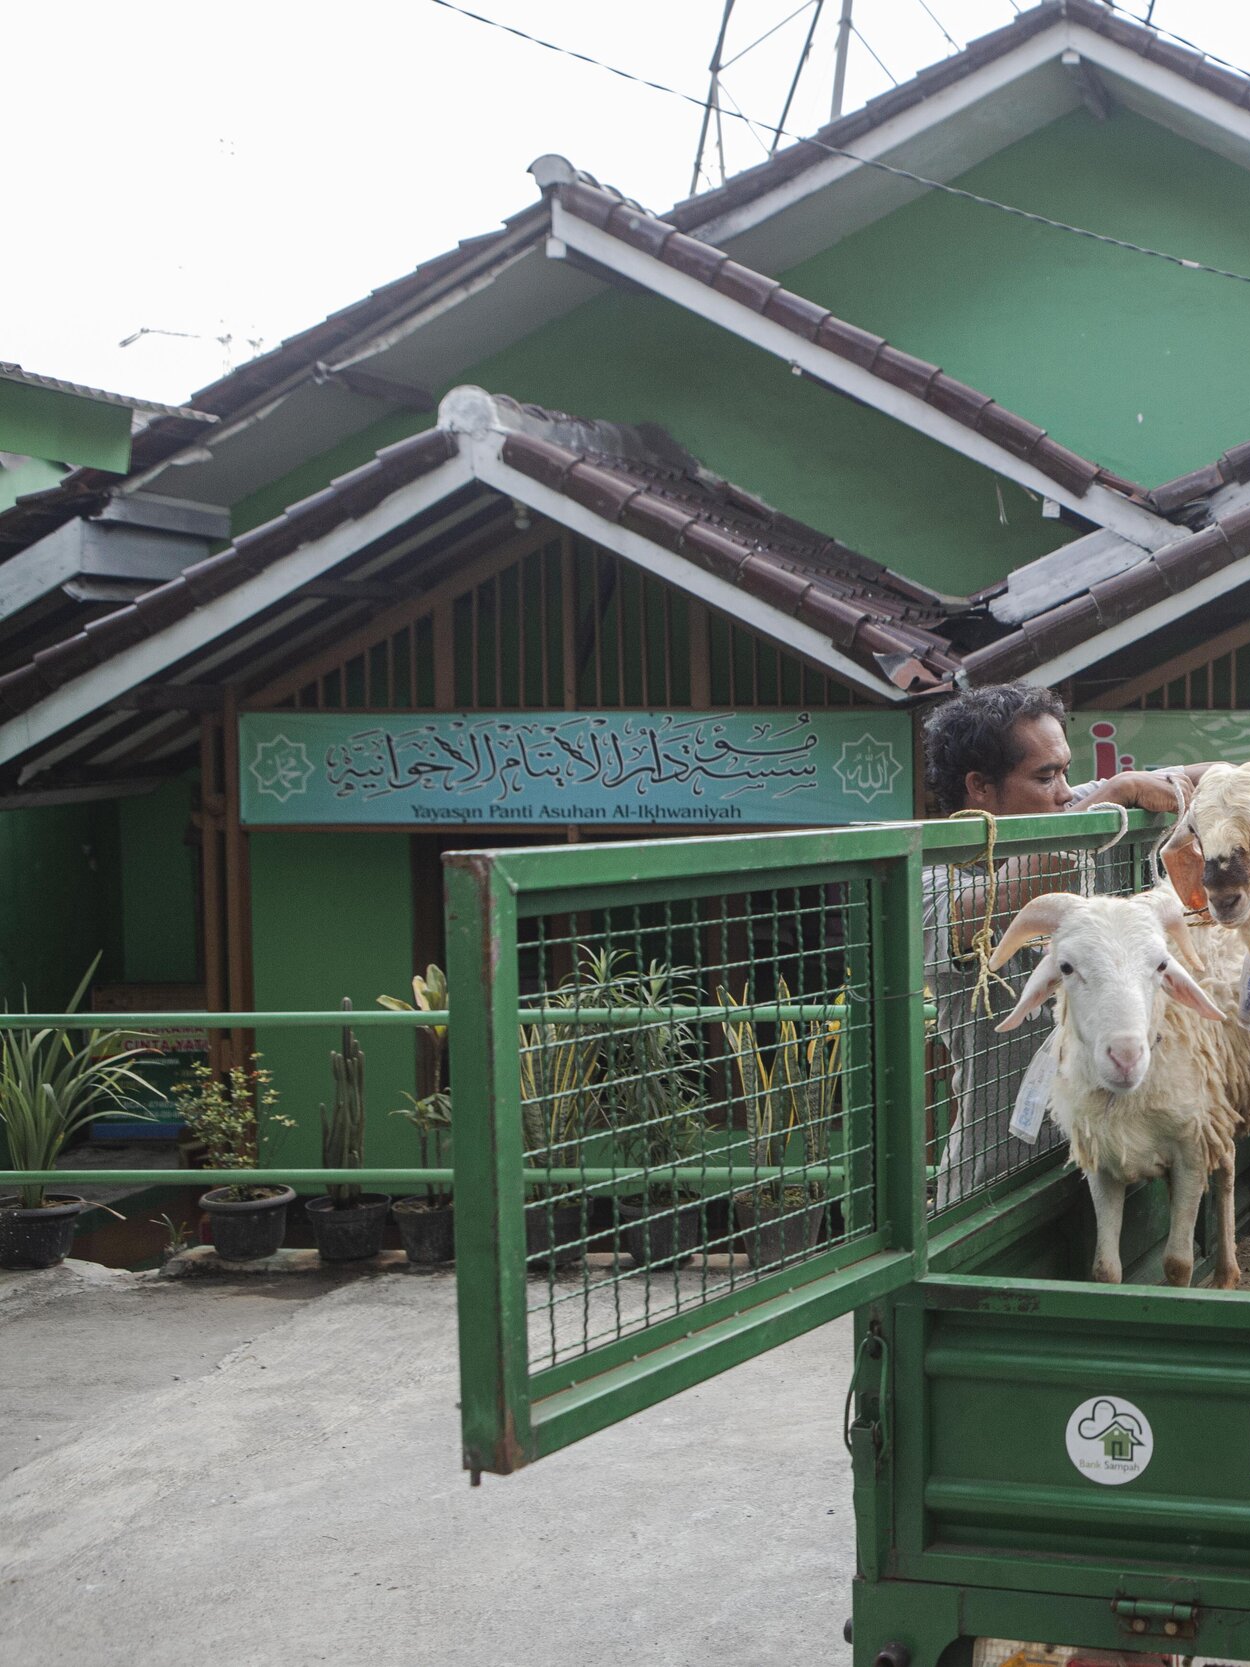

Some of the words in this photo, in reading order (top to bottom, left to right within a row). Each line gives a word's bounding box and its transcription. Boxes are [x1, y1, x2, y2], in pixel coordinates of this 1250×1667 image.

[411, 804, 483, 822] Yayasan
[489, 804, 533, 819] Panti
[539, 804, 606, 819] Asuhan
[612, 804, 742, 822] Al-Ikhwaniyah
[1079, 1458, 1101, 1469] Bank
[1104, 1460, 1140, 1473] Sampah
